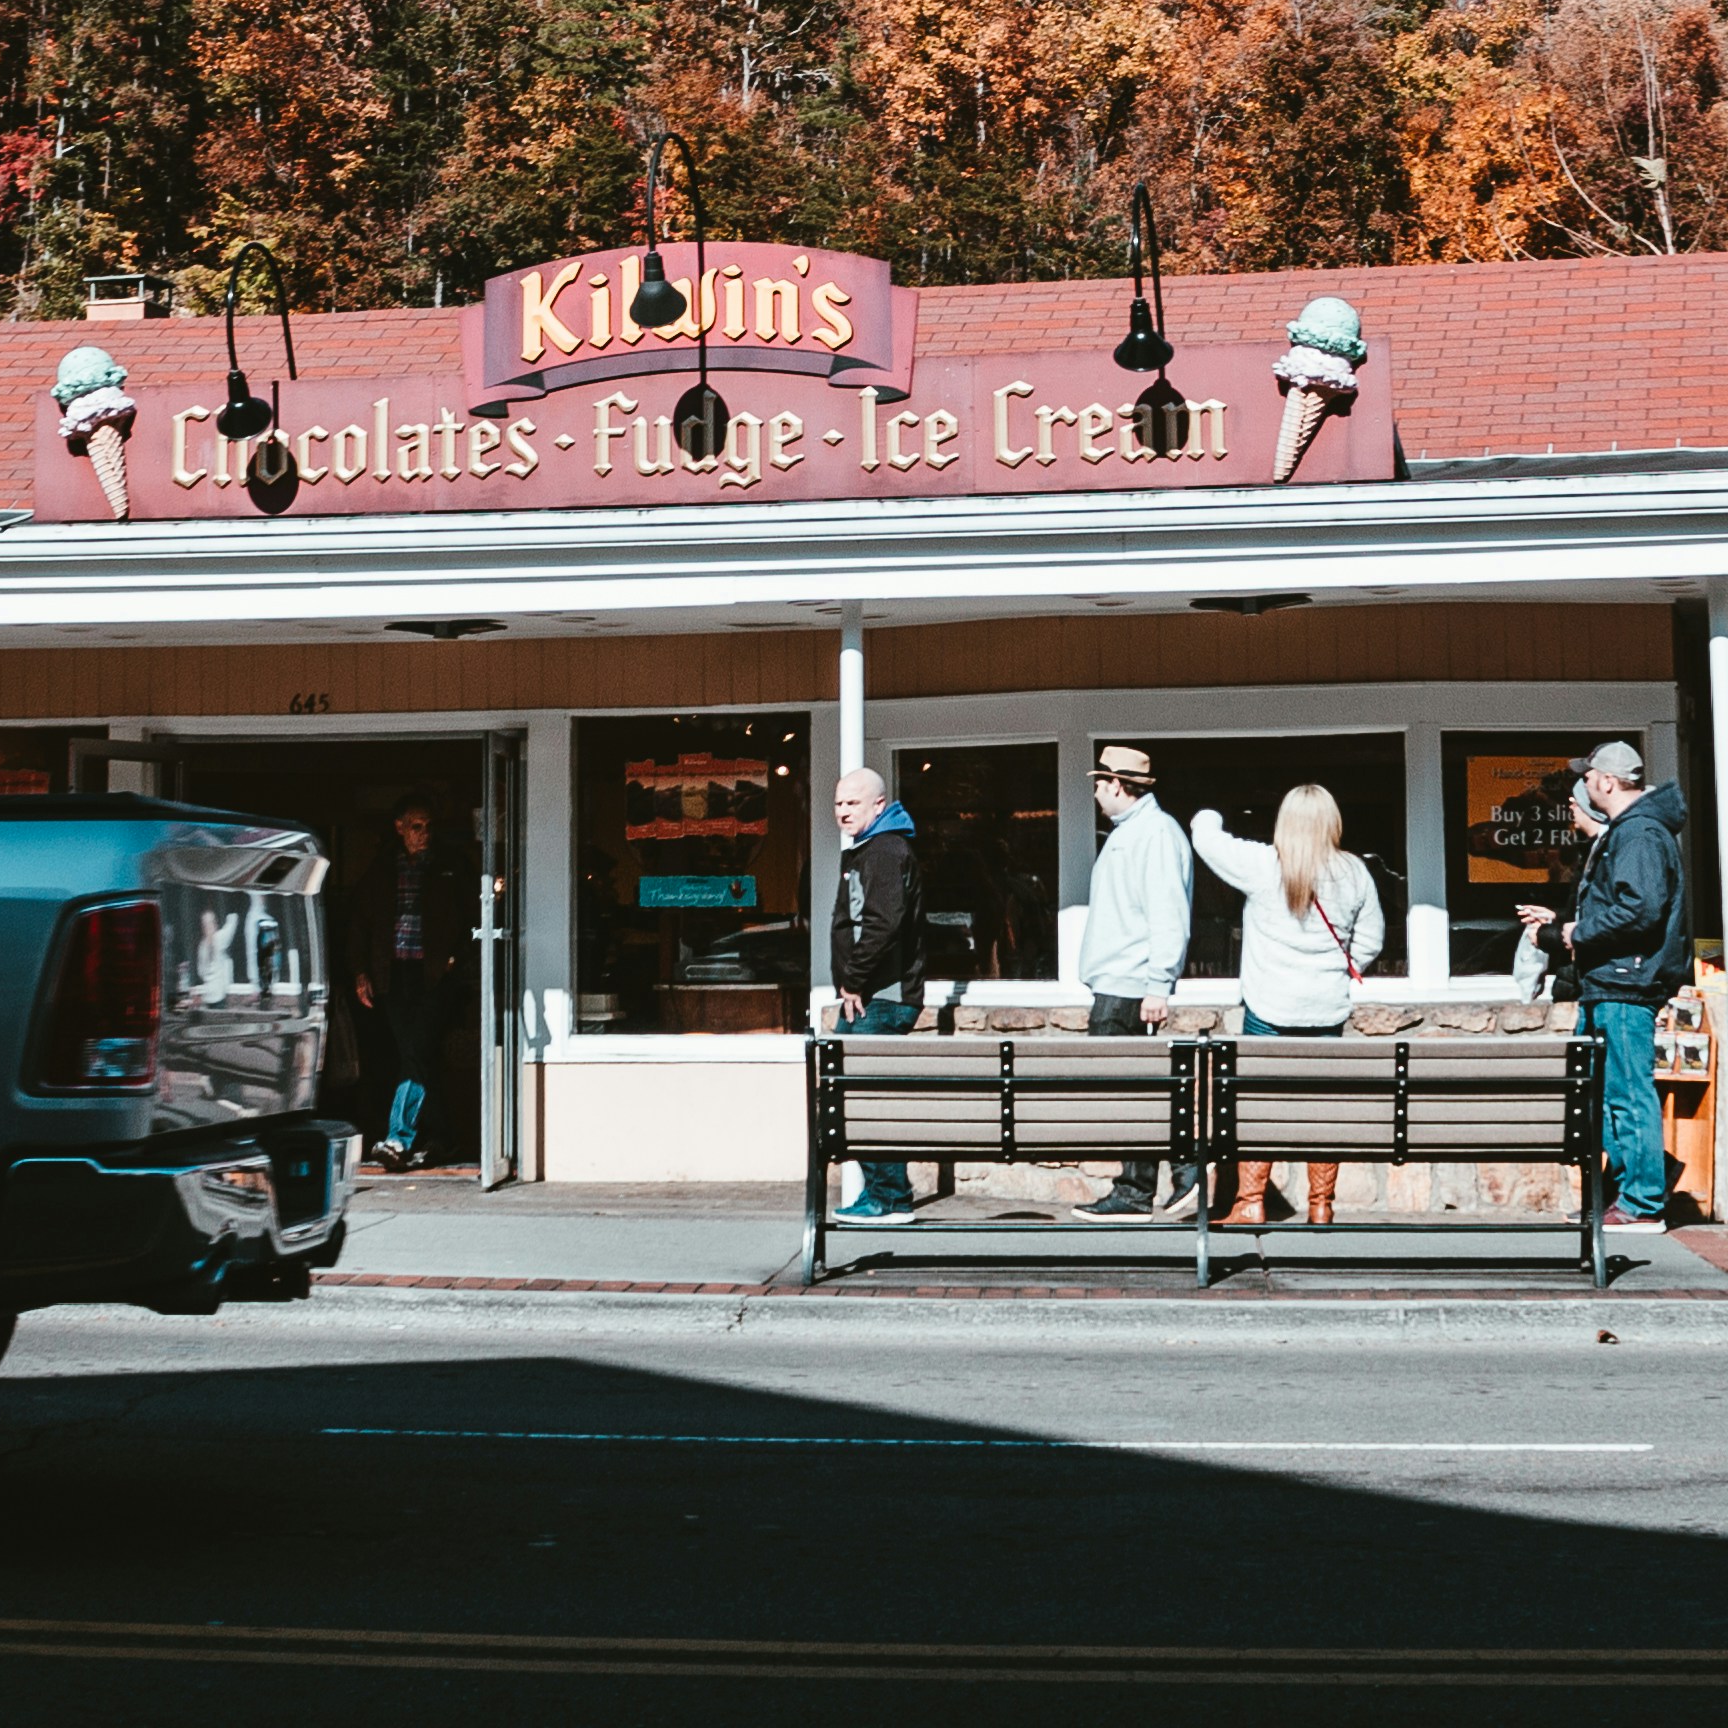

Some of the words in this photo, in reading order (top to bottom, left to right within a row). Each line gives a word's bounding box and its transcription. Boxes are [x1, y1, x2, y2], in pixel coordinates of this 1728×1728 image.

[519, 254, 854, 363] Kilwin's
[172, 397, 539, 489] Chocolates
[592, 390, 806, 489] Fudge
[858, 385, 960, 472] Ice
[992, 379, 1228, 469] Cream
[289, 692, 331, 715] 645
[1490, 804, 1524, 828] Buy
[1530, 804, 1542, 822] 3
[1547, 803, 1576, 822] slic
[1493, 828, 1527, 846] Get
[1533, 828, 1544, 844] 2
